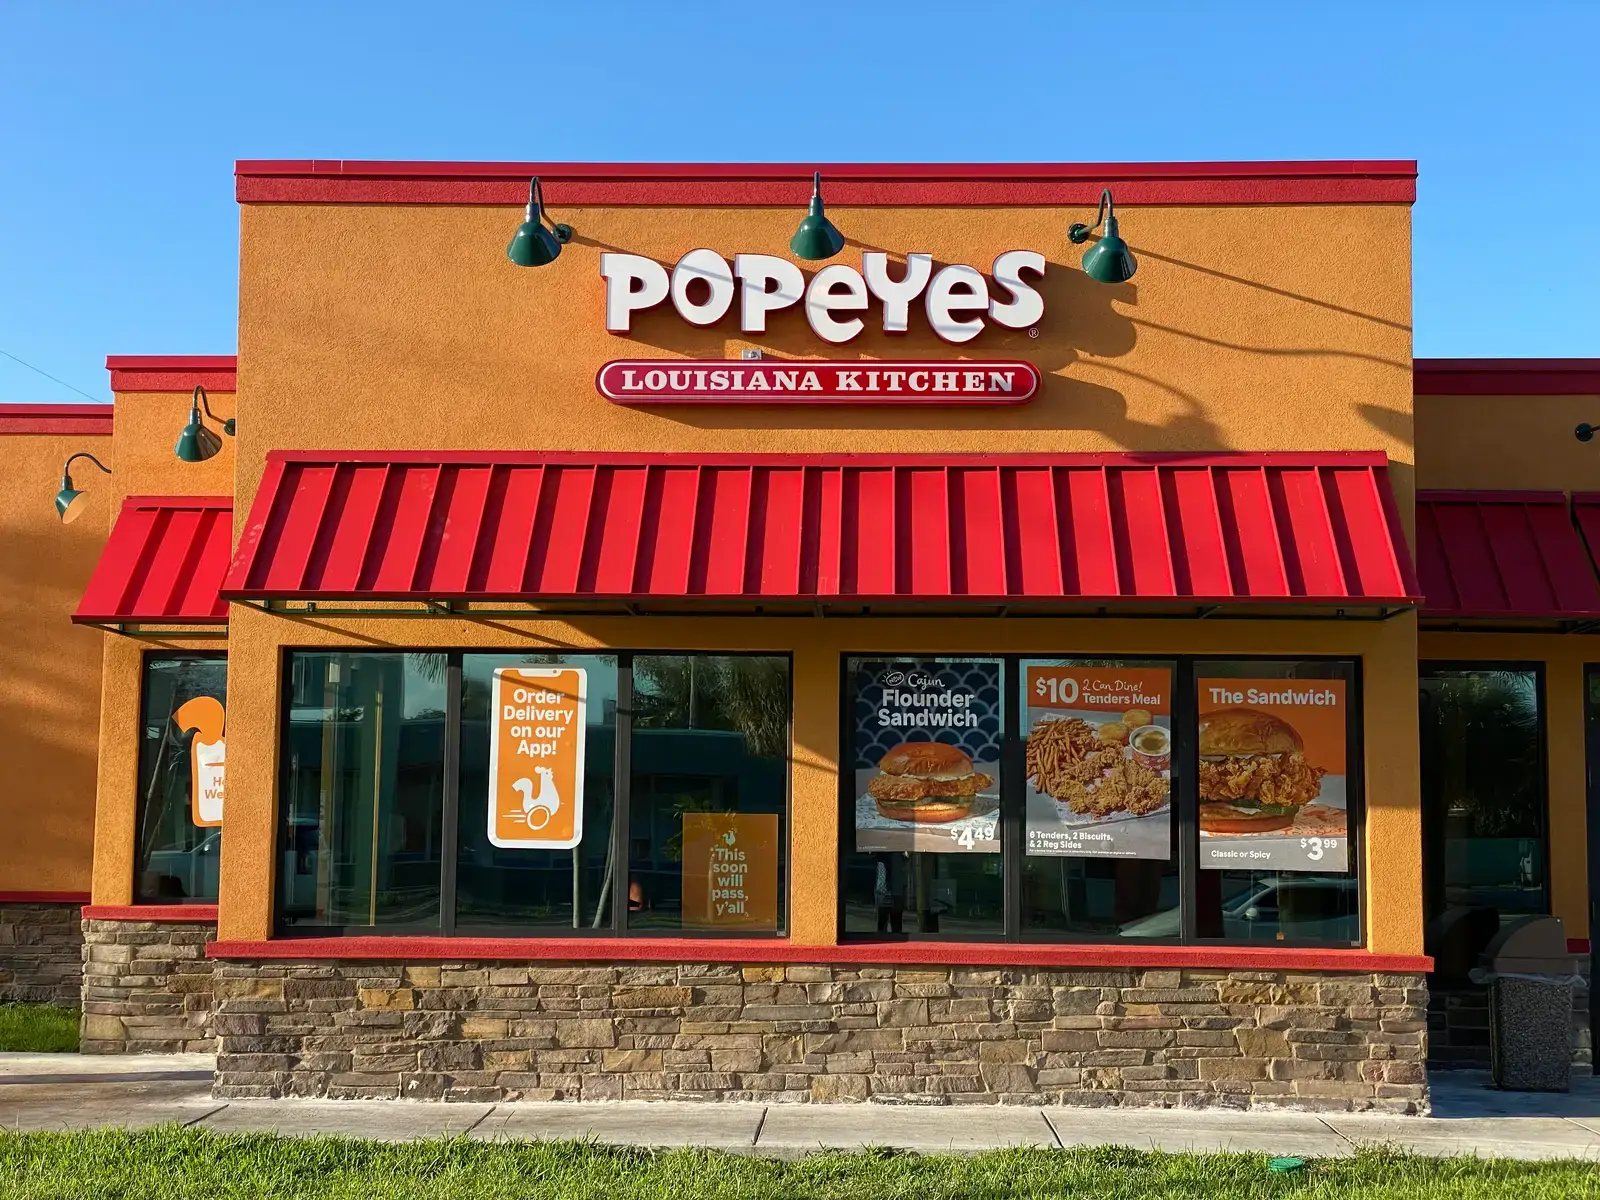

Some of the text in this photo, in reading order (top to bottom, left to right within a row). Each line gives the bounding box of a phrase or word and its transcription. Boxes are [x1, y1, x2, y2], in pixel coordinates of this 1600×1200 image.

[621, 369, 1016, 393] LOUISIANA KITCHEN
[907, 673, 946, 690] Cajun
[1082, 678, 1143, 693] 2 Can Dine!
[513, 688, 566, 704] Order
[882, 688, 975, 707] Flounder
[1035, 676, 1079, 704] $10
[1209, 687, 1336, 706] The Sandwich
[1082, 692, 1160, 705] Tenders Meal
[503, 705, 574, 725] Delivery
[878, 708, 978, 727] Sandwich
[510, 725, 566, 738] on our
[517, 739, 557, 758] App!
[1029, 830, 1114, 842] 6 Tenders, 2 Biscuits,
[1029, 840, 1036, 848] &
[1043, 841, 1059, 849] Reg
[1060, 841, 1082, 849] Sides
[715, 848, 746, 861] This
[1211, 849, 1239, 858] Classic
[1249, 850, 1271, 859] Spicy
[713, 863, 748, 874] soon
[717, 874, 743, 887] will
[712, 888, 749, 902] pass,
